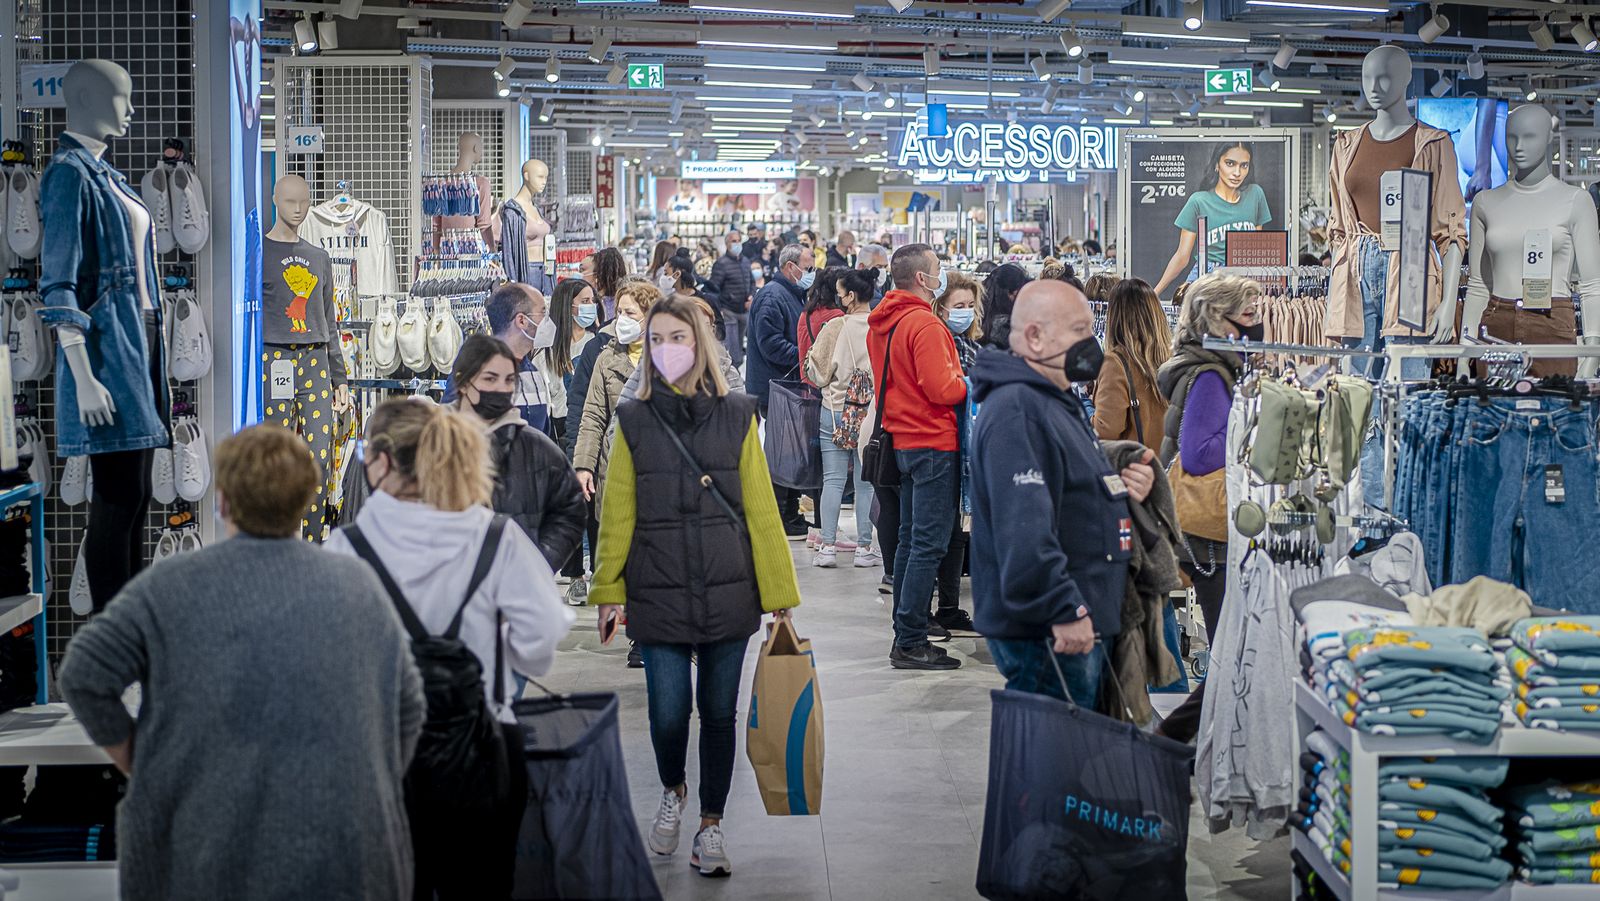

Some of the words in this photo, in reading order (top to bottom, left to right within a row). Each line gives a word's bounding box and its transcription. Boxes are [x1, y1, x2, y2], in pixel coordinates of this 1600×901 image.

[295, 134, 318, 146] 16€
[1140, 184, 1186, 204] 2.70€
[319, 235, 369, 249] STITCH
[1233, 249, 1281, 257] DESCUENTOS
[1527, 251, 1544, 264] 8€
[280, 256, 294, 266] WILD
[294, 255, 310, 267] CHILD
[1233, 257, 1281, 265] DESCUENTOS
[274, 377, 291, 386] 12€
[1065, 794, 1161, 840] PRIMARK
